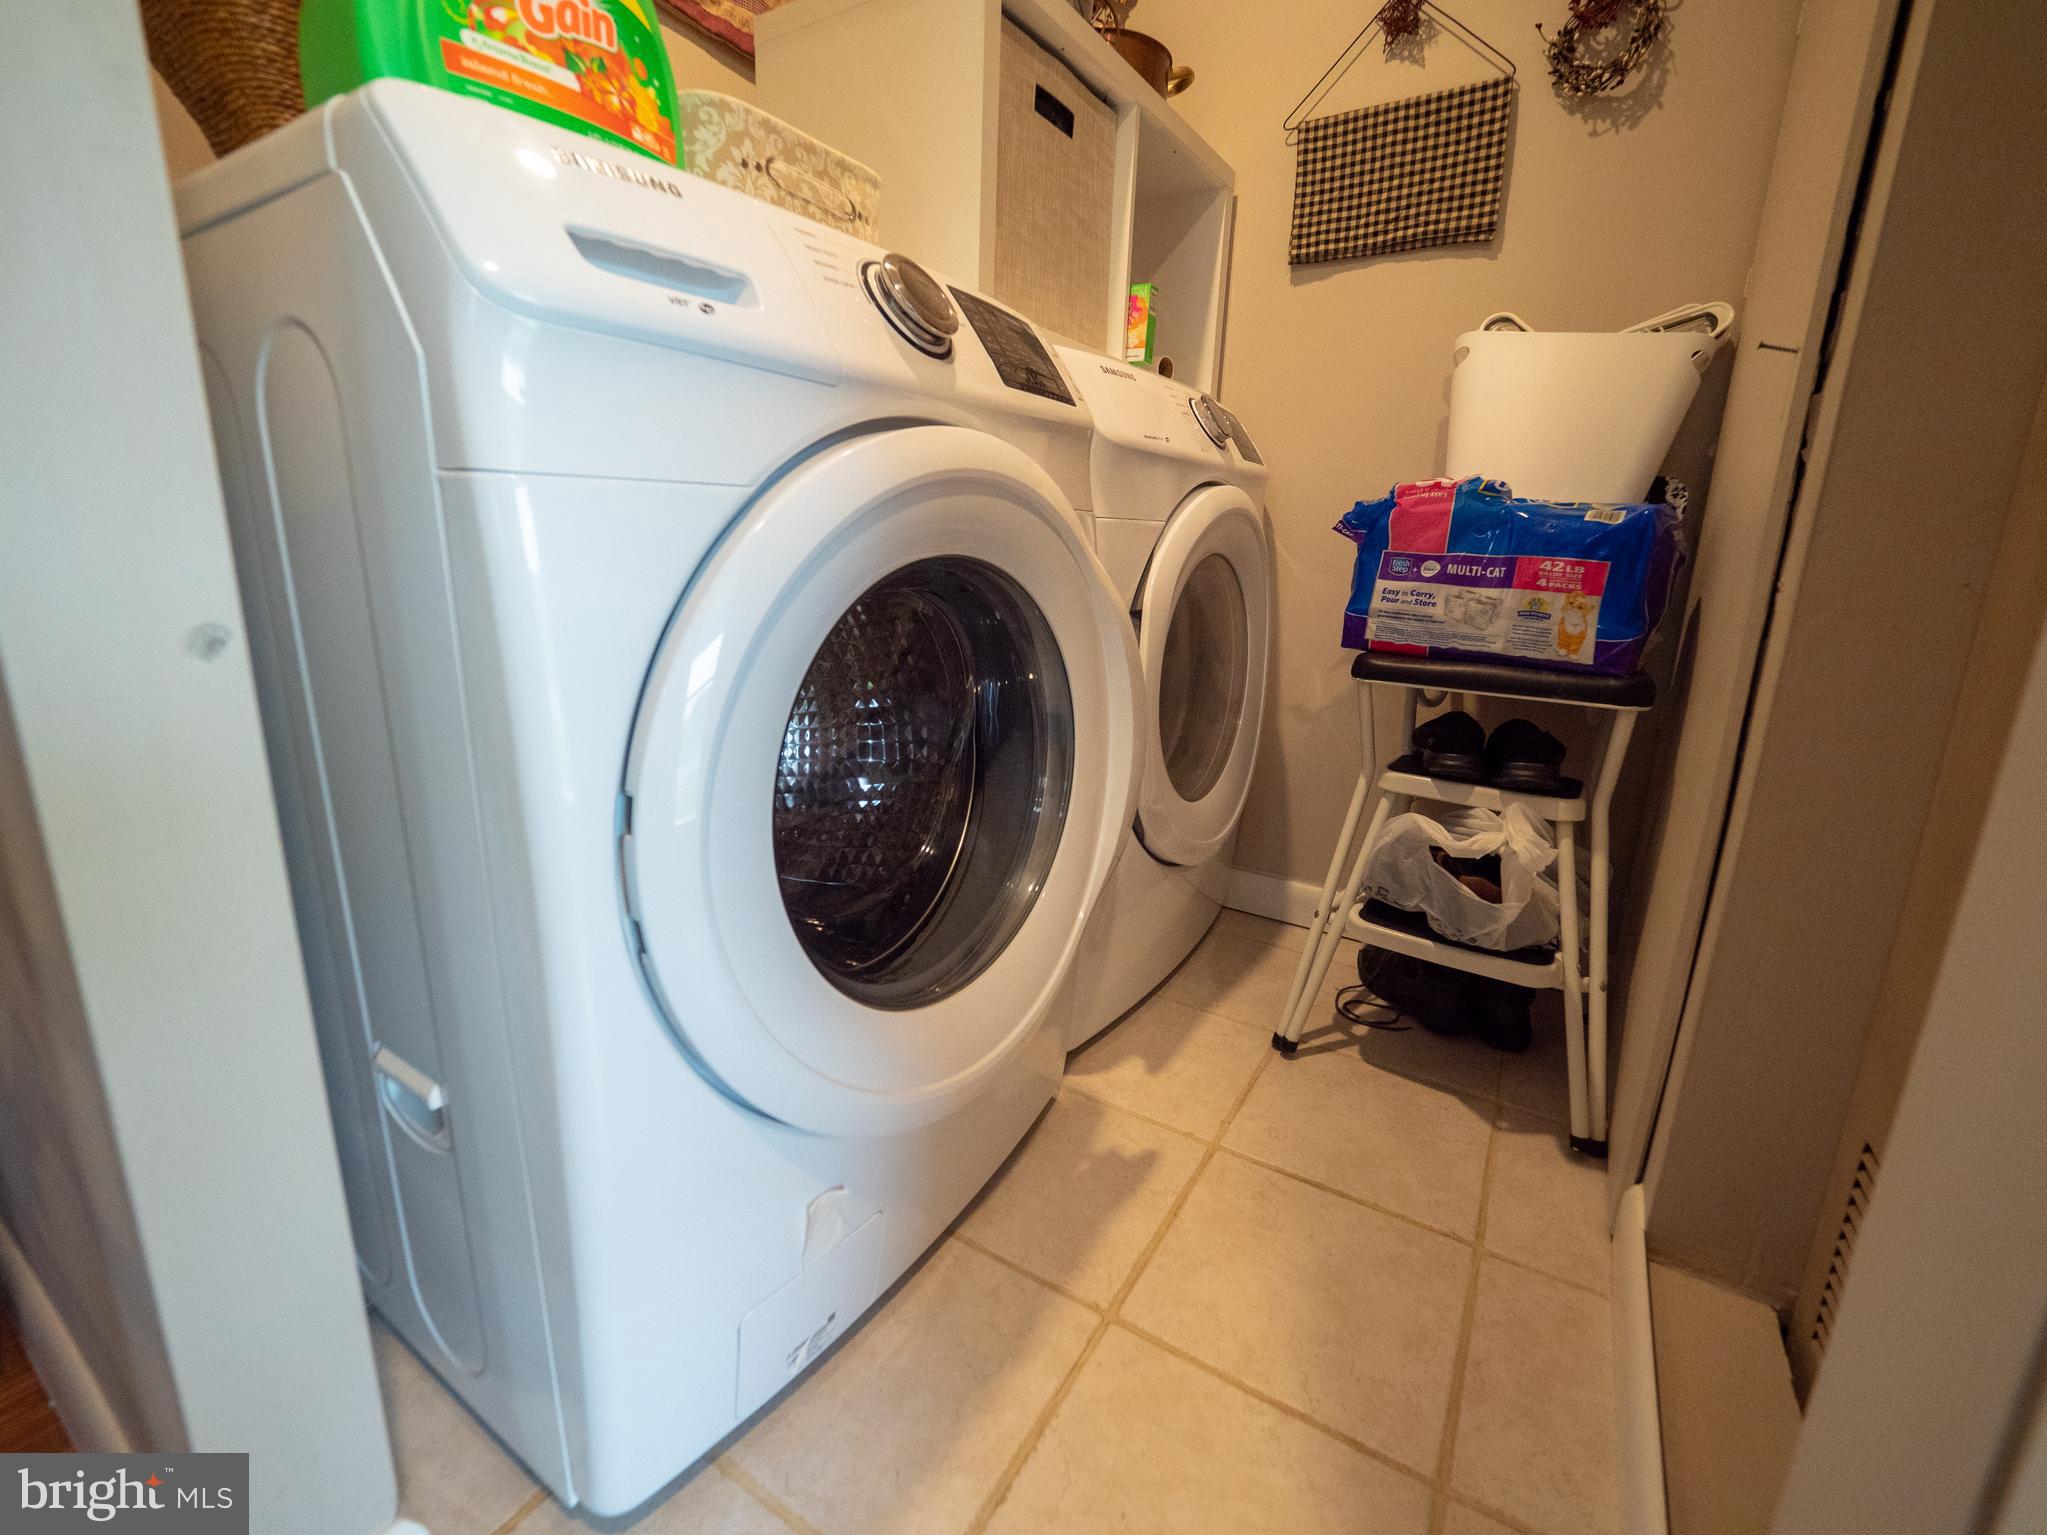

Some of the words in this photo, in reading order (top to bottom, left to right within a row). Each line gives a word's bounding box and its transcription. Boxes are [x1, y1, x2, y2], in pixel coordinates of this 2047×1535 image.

[516, 0, 618, 53] Gain
[1391, 565, 1409, 574] Step
[1392, 558, 1410, 568] Fresh
[1446, 563, 1506, 578] MULTI-CAT
[1548, 581, 1582, 590] PACKS
[1382, 587, 1401, 597] Easy
[1410, 589, 1436, 600] Carry,
[1380, 595, 1400, 605] Pour
[1400, 598, 1413, 606] and
[1413, 598, 1437, 608] Store
